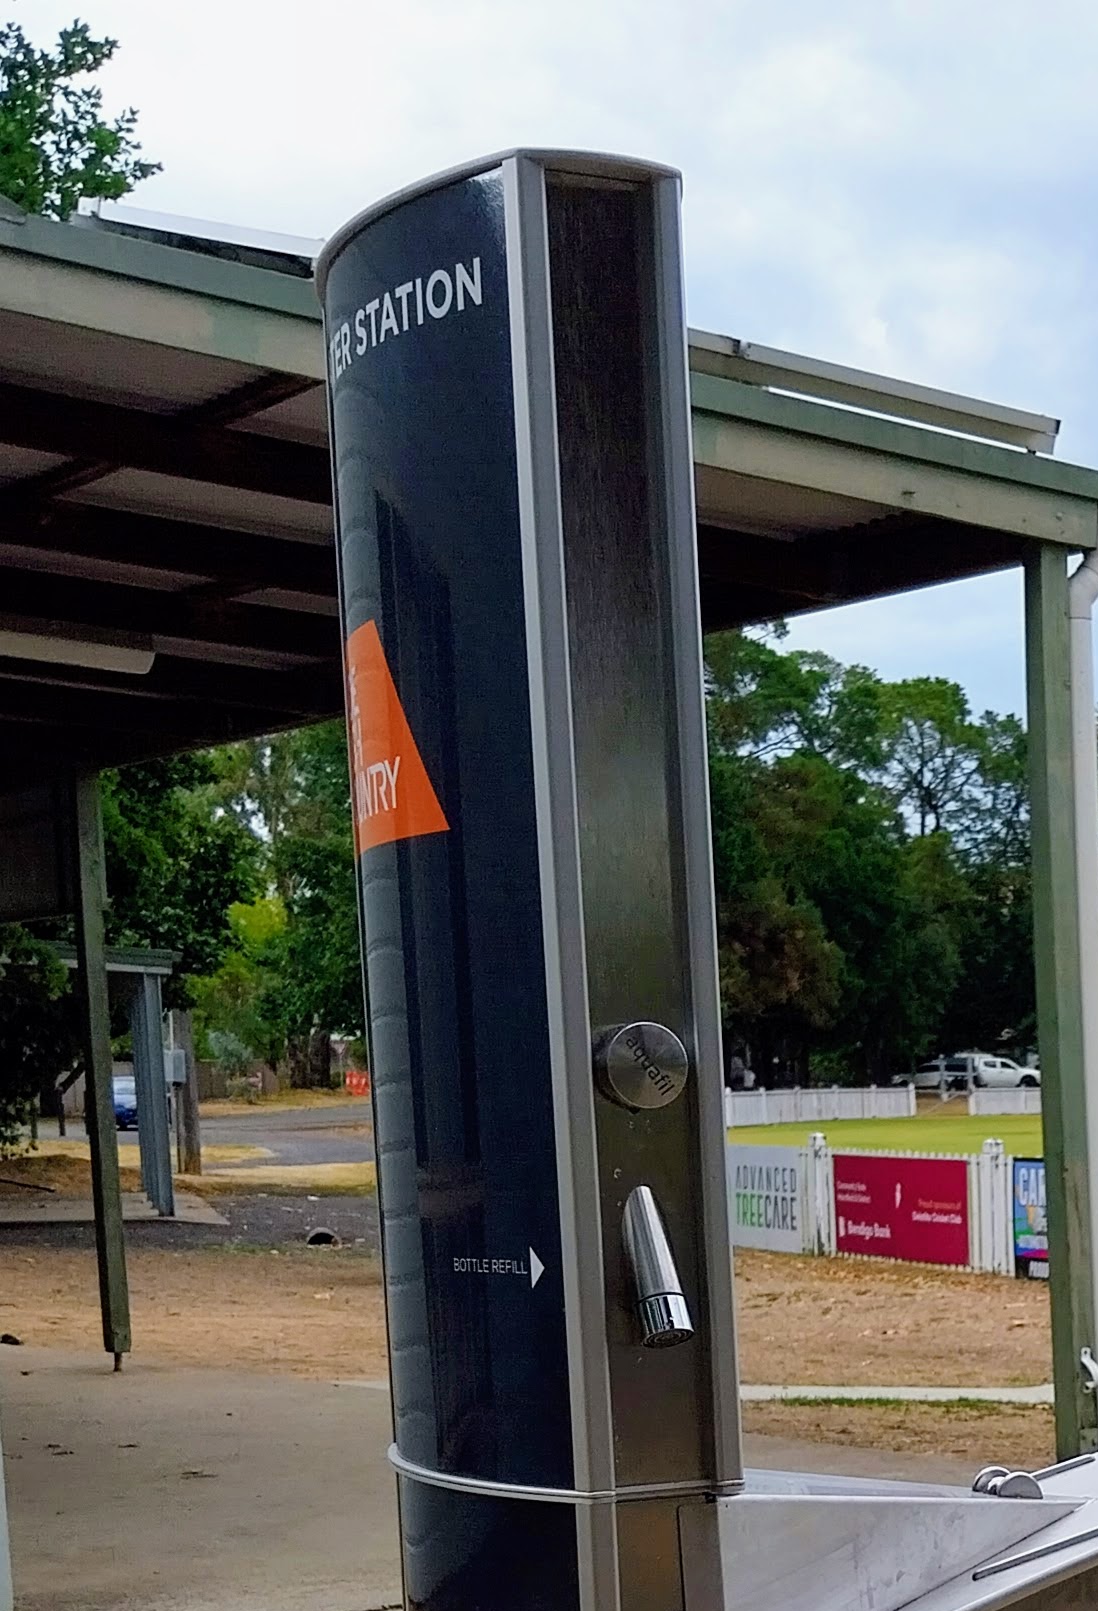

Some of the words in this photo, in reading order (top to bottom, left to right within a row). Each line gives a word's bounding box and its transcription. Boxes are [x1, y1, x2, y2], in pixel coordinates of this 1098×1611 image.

[355, 256, 482, 356] STATION
[626, 1037, 675, 1096] aquafil
[736, 1165, 797, 1192] ADVANCED
[847, 1220, 874, 1240] Bendigo
[874, 1222, 891, 1238] Bank
[453, 1257, 489, 1273] BOTTLE
[491, 1259, 528, 1274] REFILL
